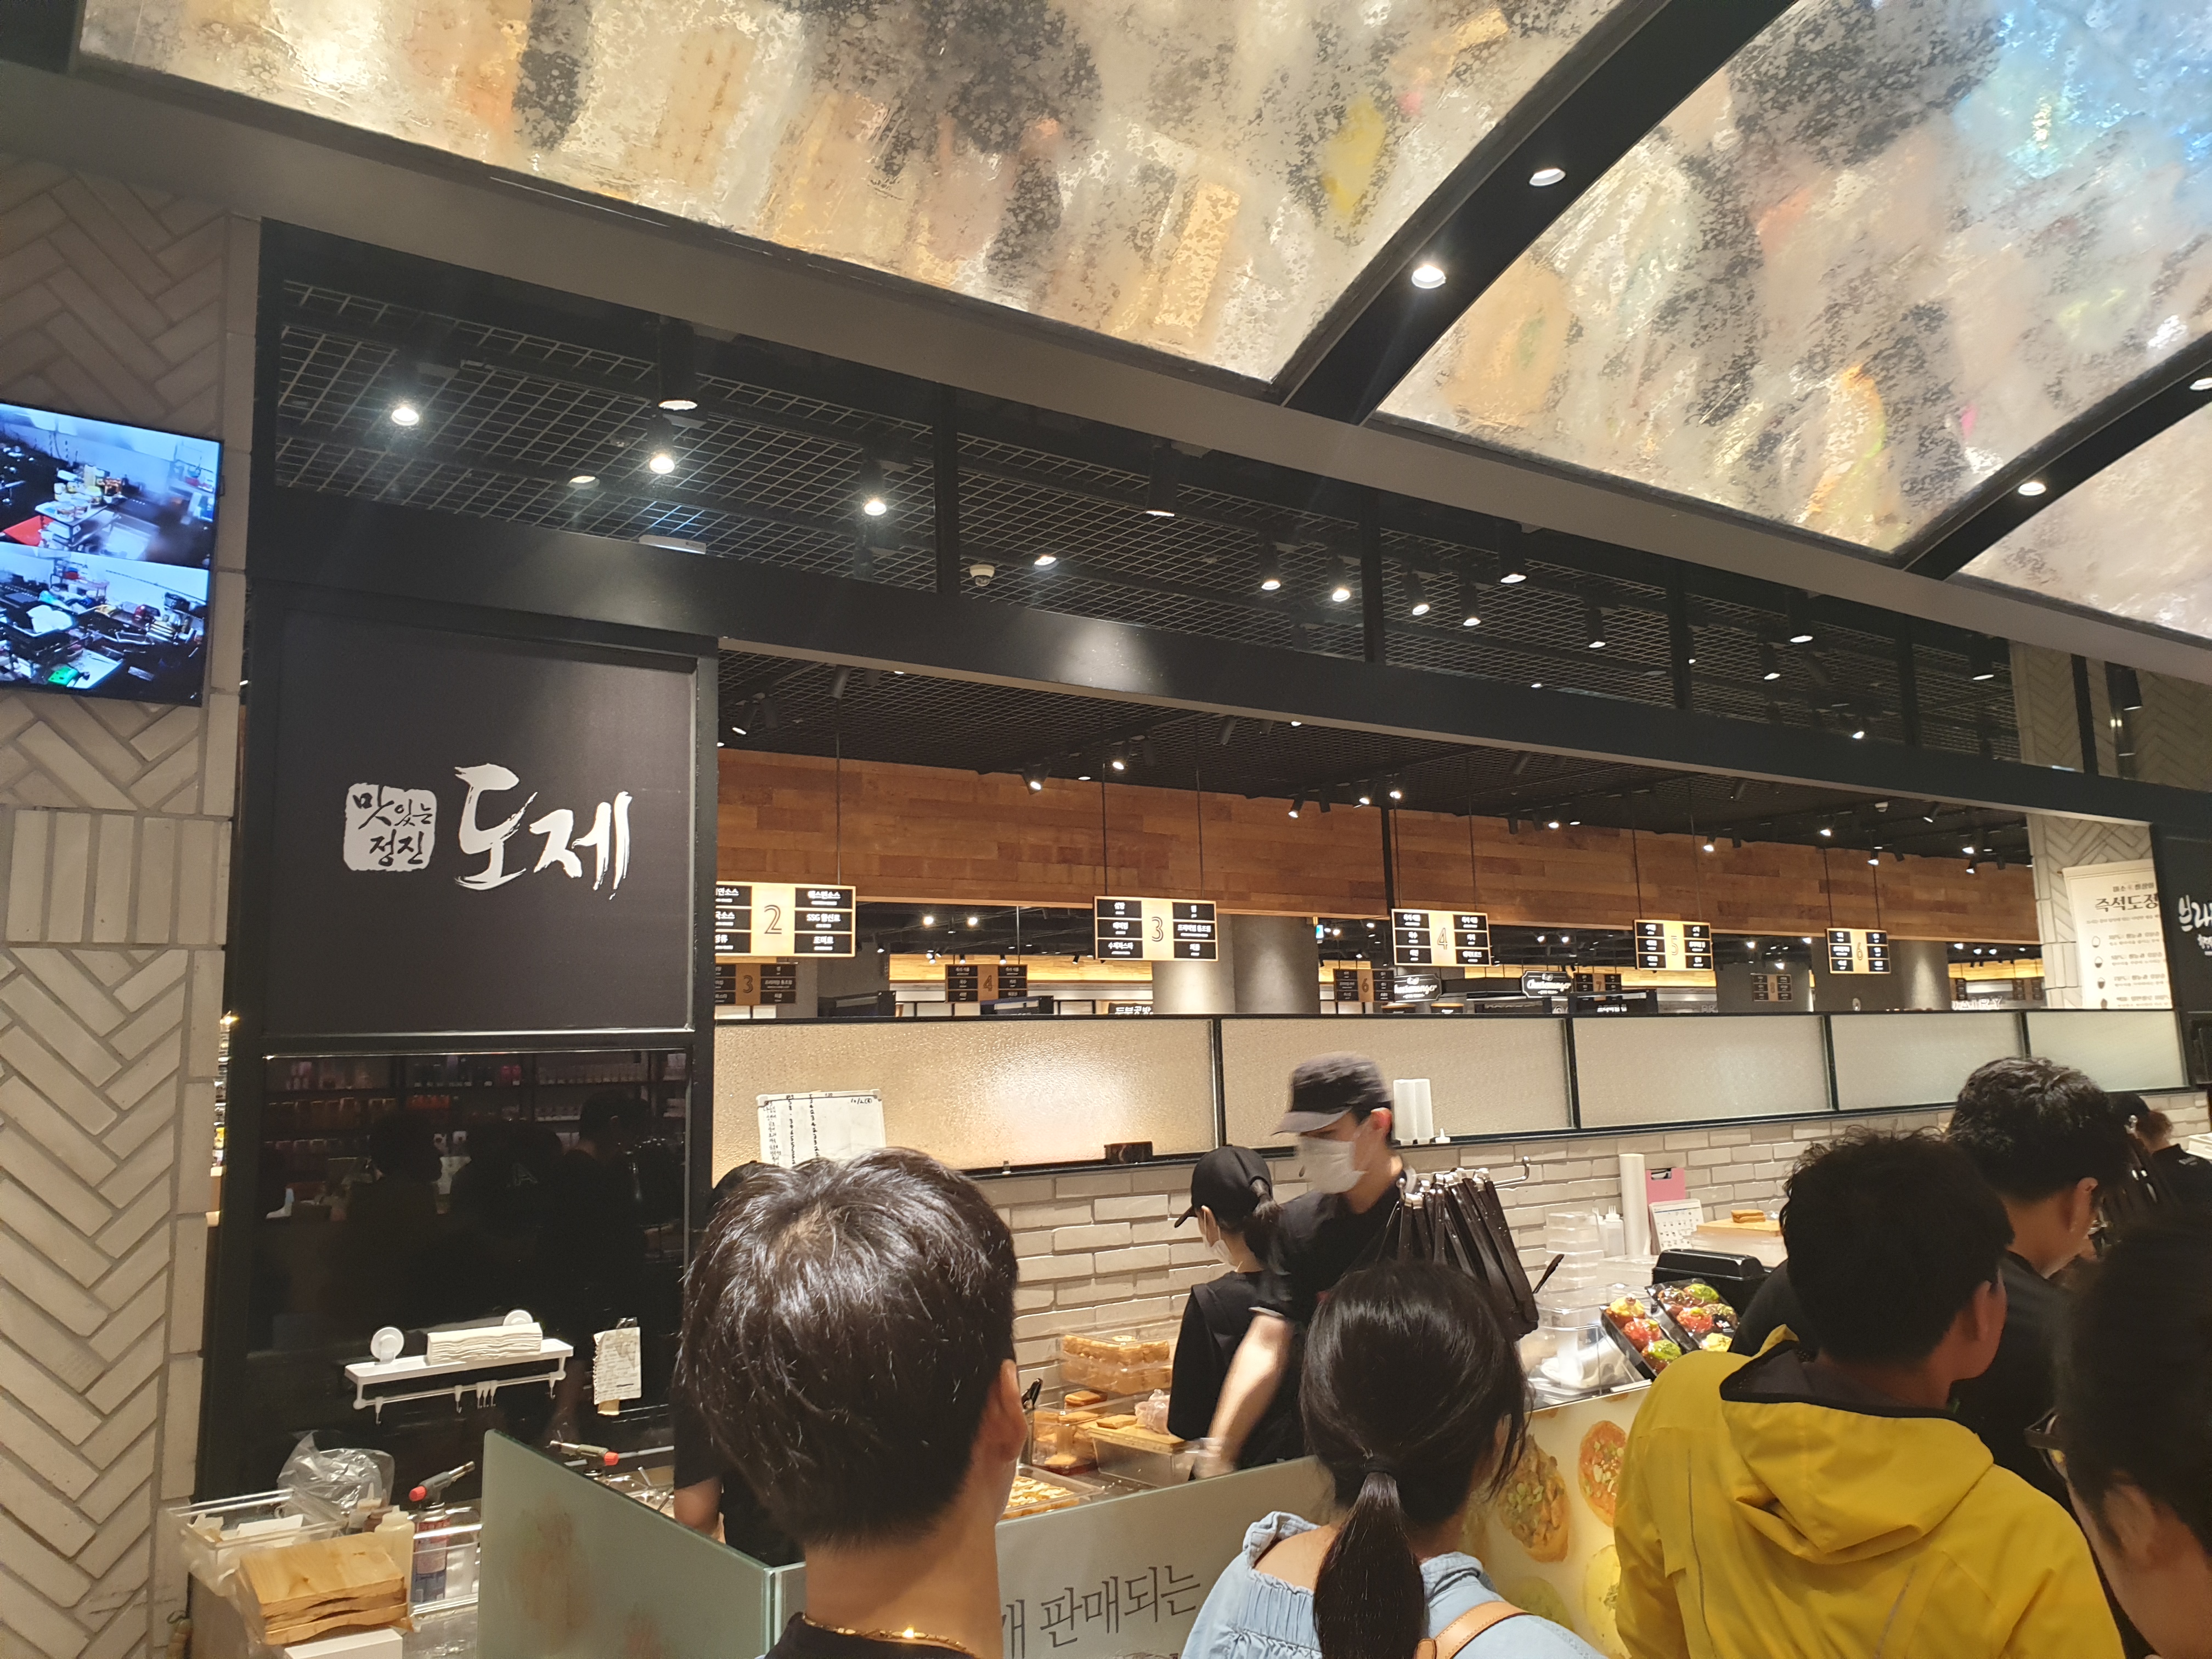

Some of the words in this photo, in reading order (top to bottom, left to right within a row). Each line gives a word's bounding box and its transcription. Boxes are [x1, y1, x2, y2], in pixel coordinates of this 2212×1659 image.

[353, 785, 433, 830] 맛있는
[454, 763, 633, 900] 도제
[369, 829, 424, 866] 정진
[764, 904, 782, 935] 2
[1151, 916, 1164, 942] 3
[1437, 927, 1448, 950] 4
[1671, 935, 1679, 956] 5
[1856, 942, 1864, 961] 6
[742, 974, 754, 994] 3
[983, 974, 993, 992] 4
[1361, 978, 1369, 992] 6
[1040, 1565, 1201, 1648] 판매되는
